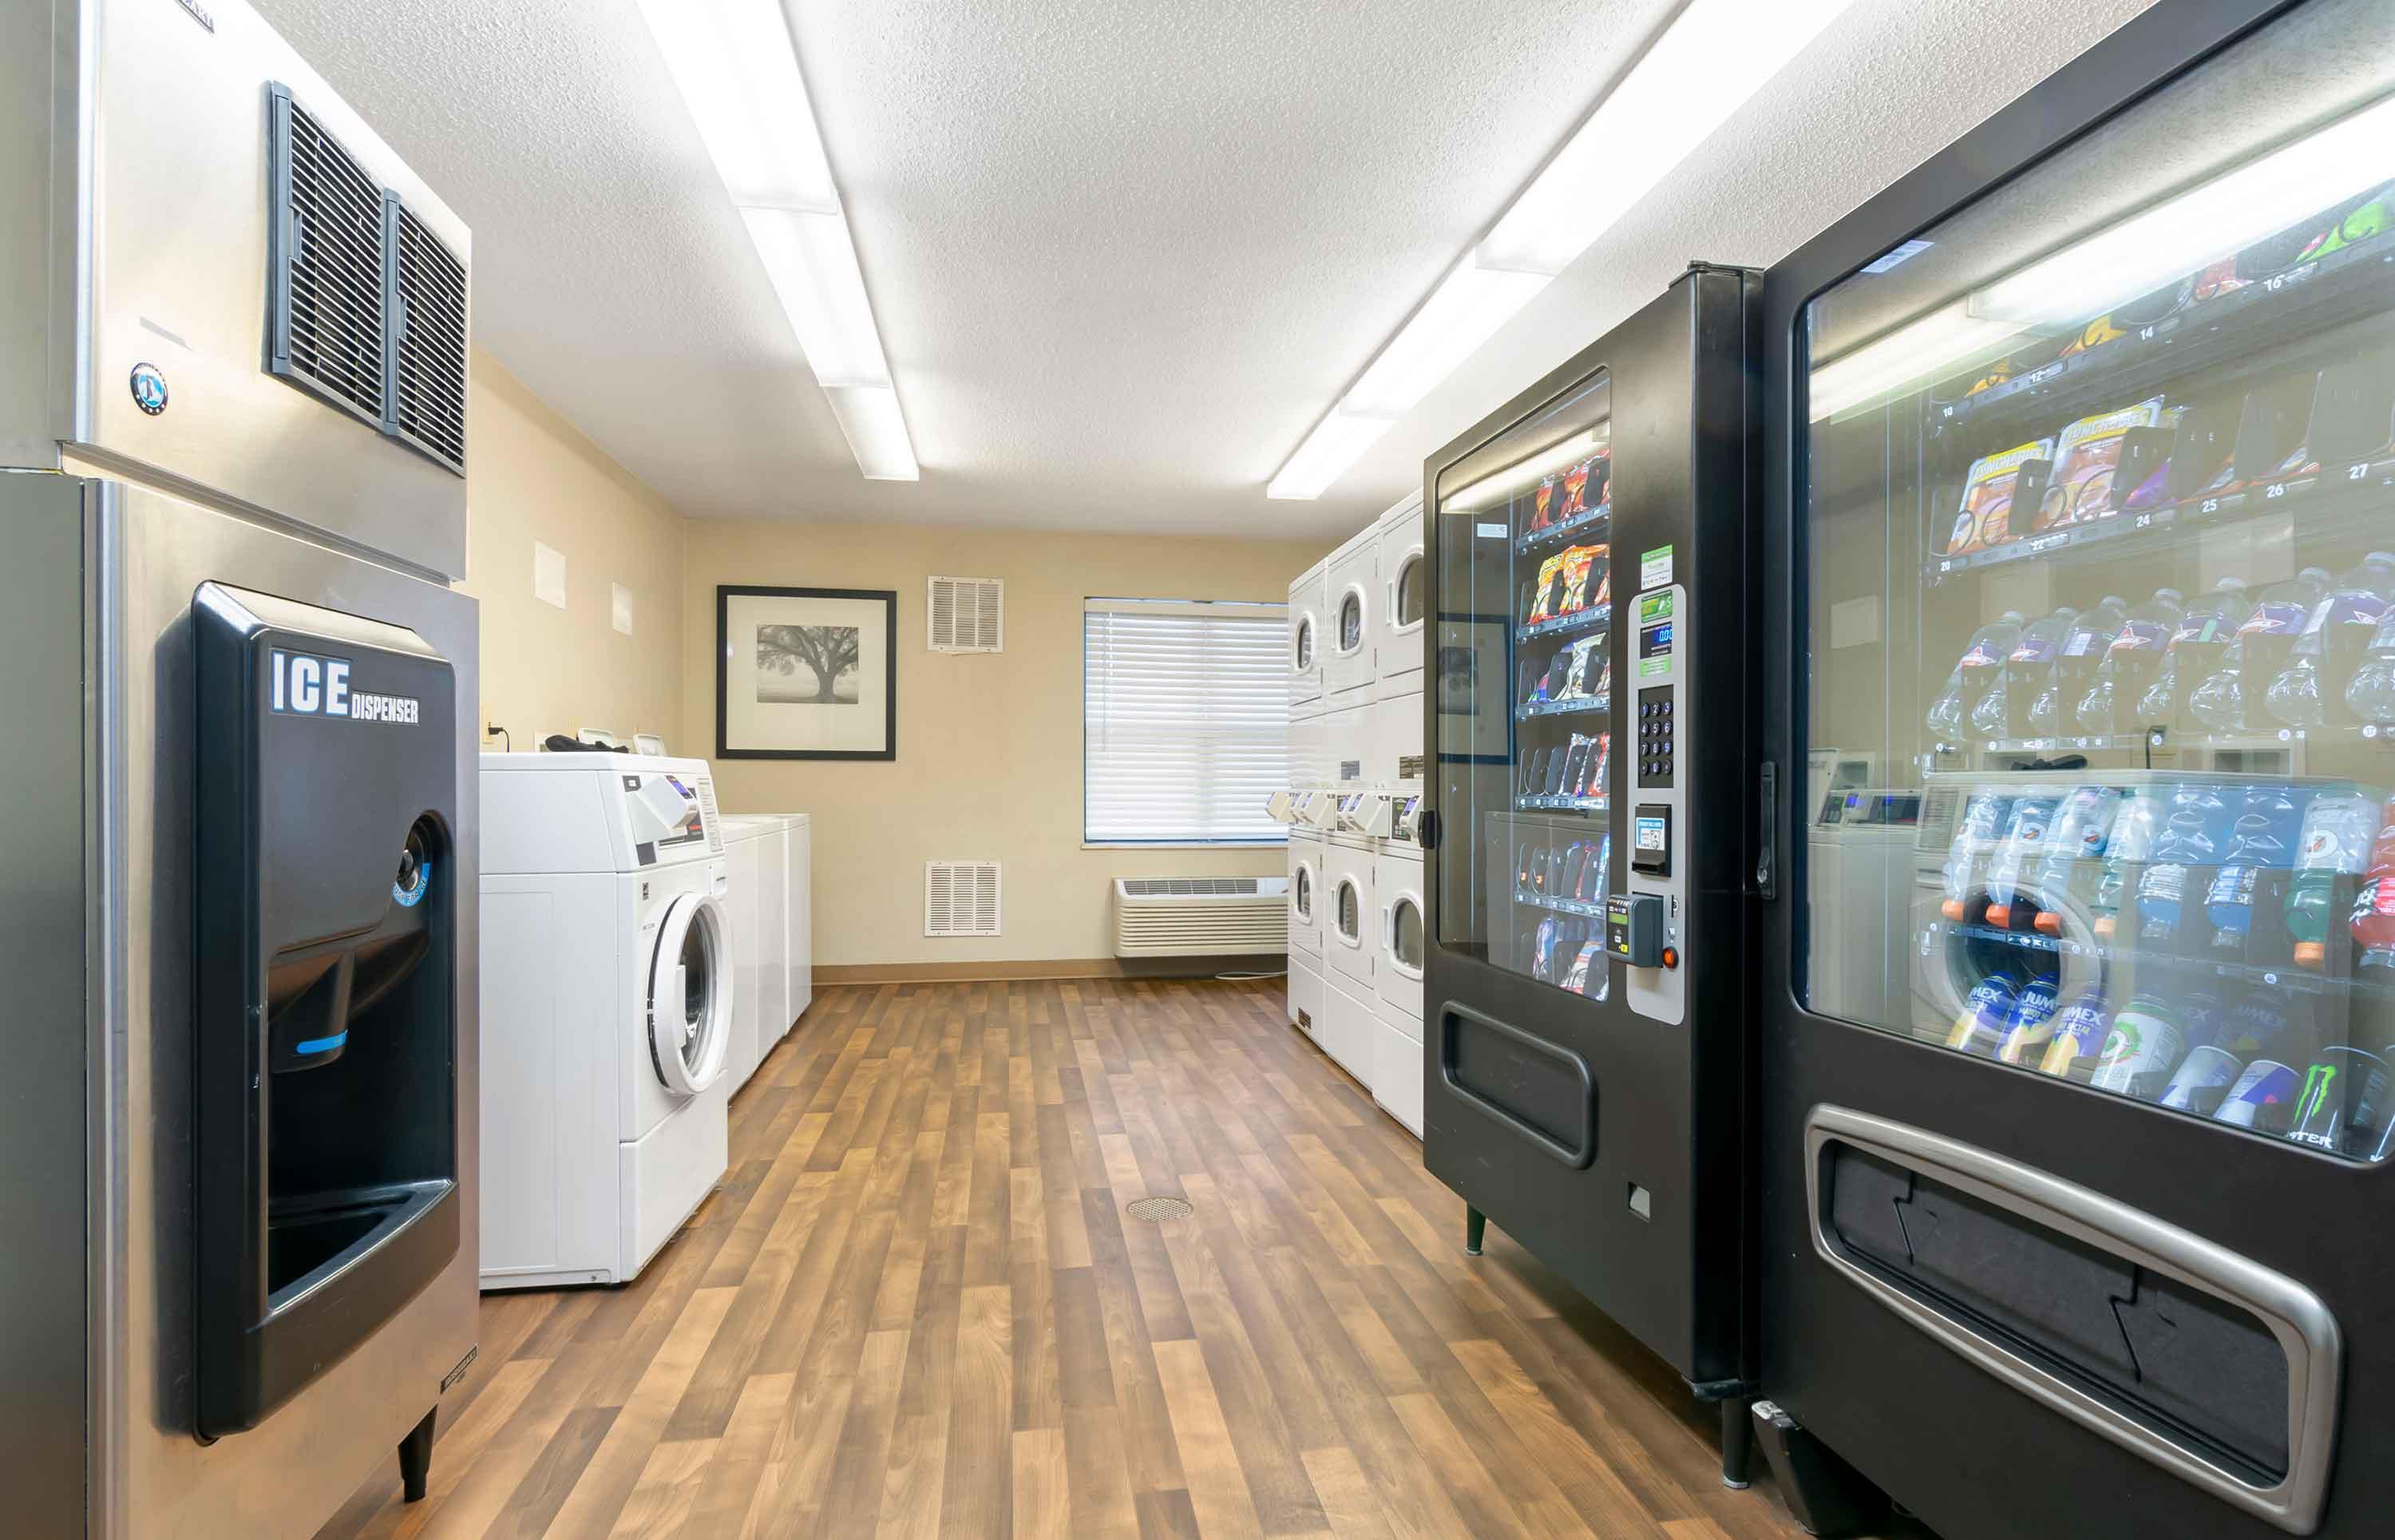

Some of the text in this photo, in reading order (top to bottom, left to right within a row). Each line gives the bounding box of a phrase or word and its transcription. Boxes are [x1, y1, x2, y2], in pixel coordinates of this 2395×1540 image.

[2140, 326, 2154, 341] 14
[1942, 406, 1954, 418] 10
[2349, 463, 2369, 479] 27
[2266, 483, 2284, 497] 26
[2203, 498, 2217, 513] 25
[2136, 514, 2151, 528] 24
[1941, 560, 1951, 572] 20
[273, 652, 419, 723] ICE DISPENSER
[1969, 986, 2003, 1004] MEX
[2022, 991, 2057, 1011] JUM
